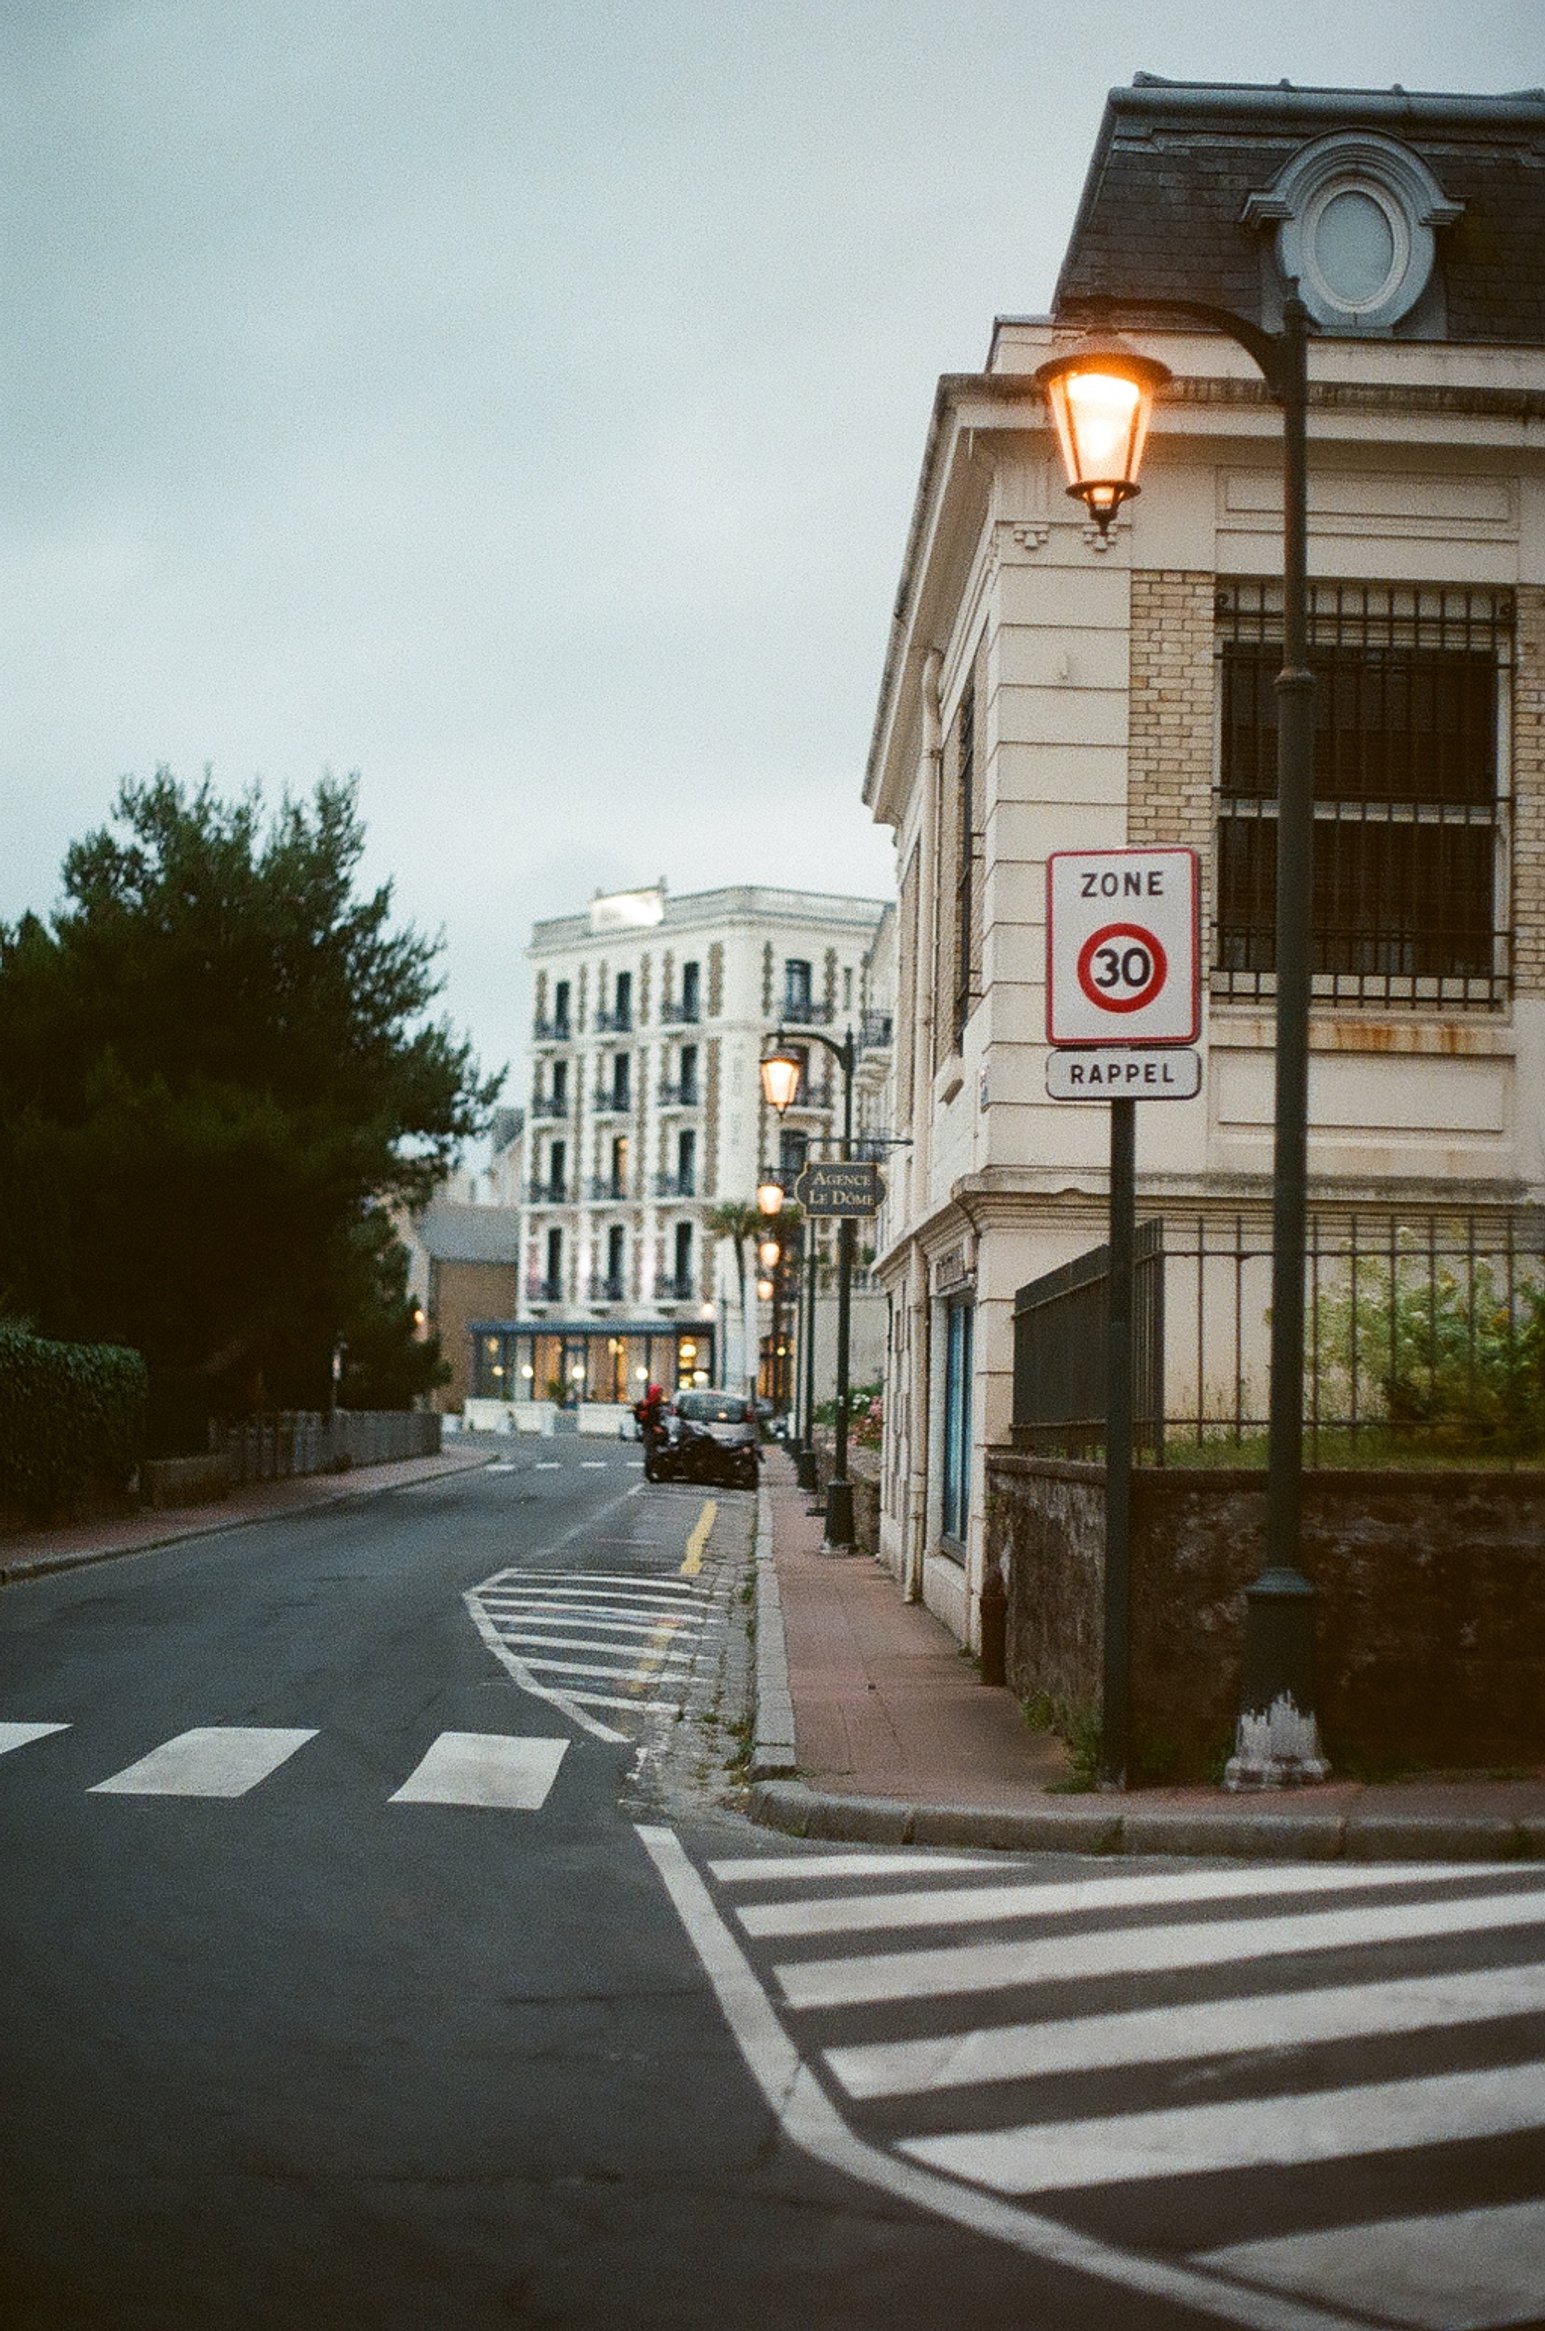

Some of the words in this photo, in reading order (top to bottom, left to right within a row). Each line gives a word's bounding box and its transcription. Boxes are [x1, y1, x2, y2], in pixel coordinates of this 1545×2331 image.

[1081, 871, 1164, 898] ZONE
[1094, 947, 1151, 988] 30
[1070, 1062, 1175, 1084] RAPPEL
